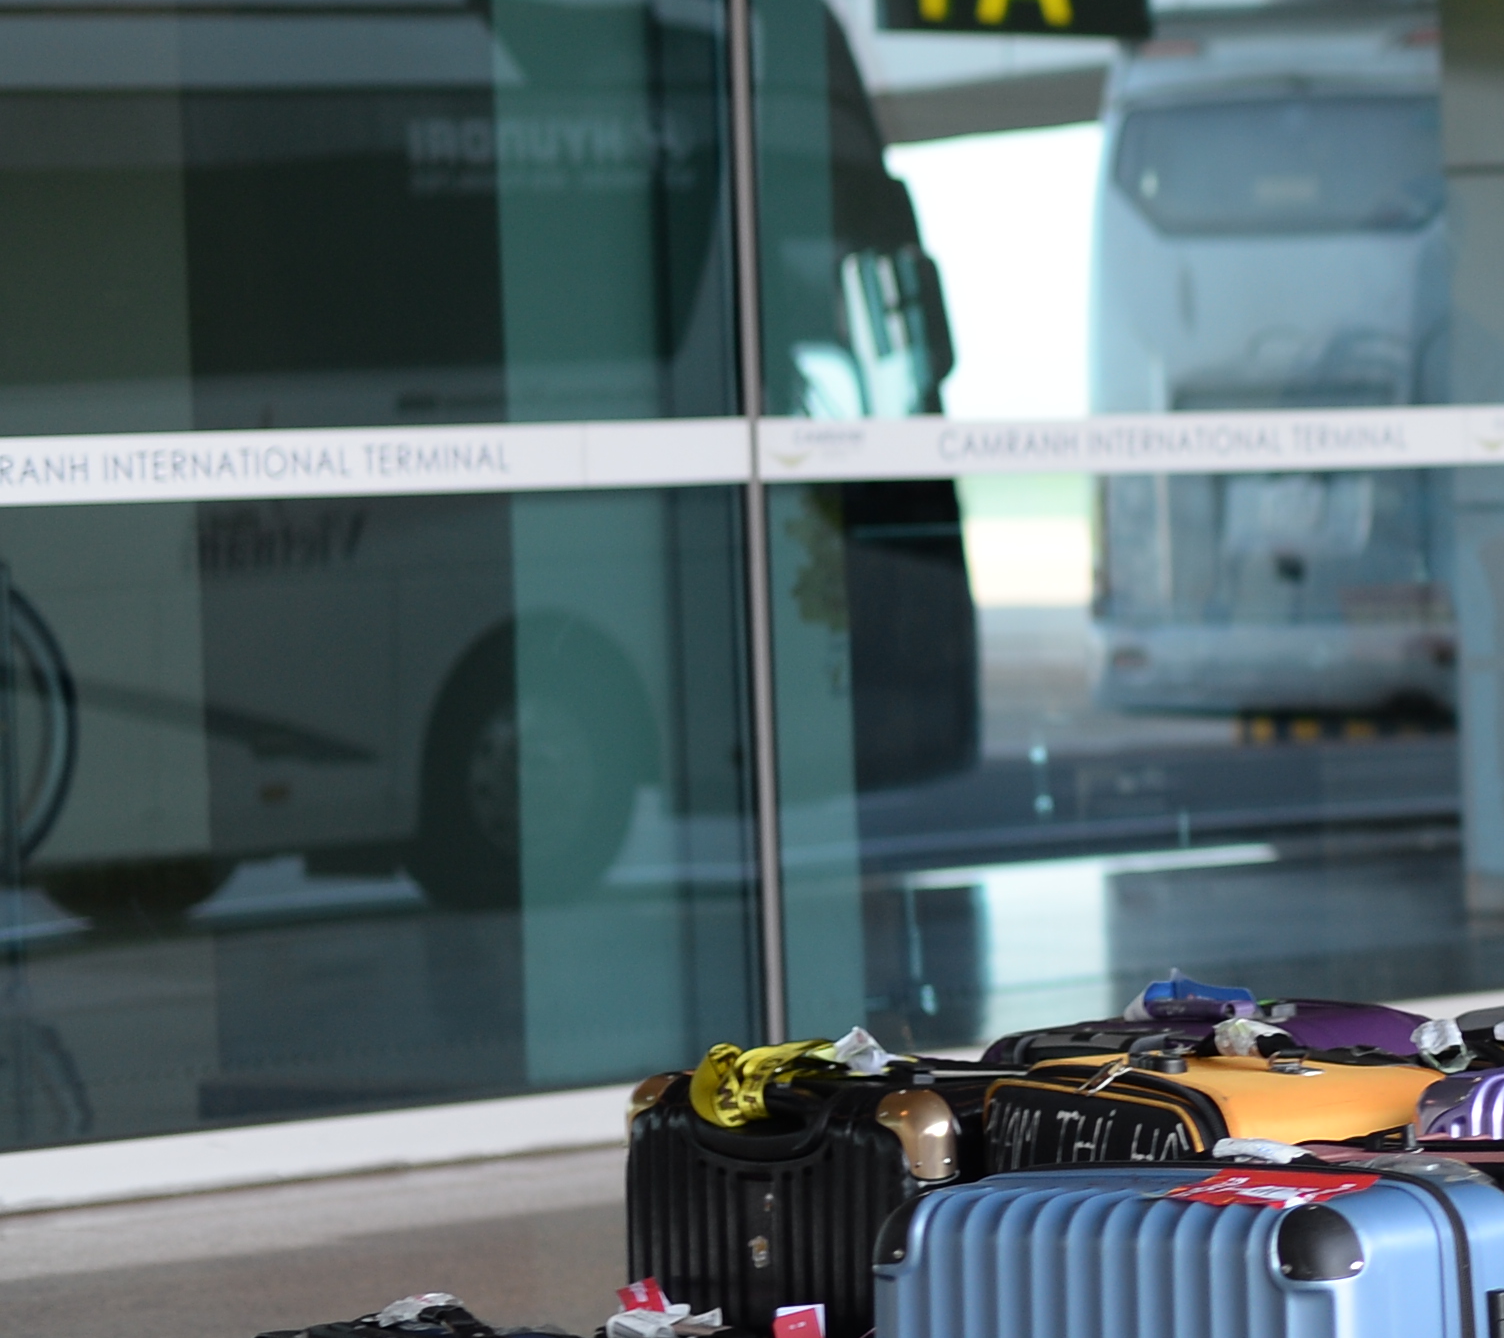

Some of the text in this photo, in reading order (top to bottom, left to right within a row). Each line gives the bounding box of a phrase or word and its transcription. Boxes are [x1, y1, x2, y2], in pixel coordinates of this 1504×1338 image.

[939, 419, 1408, 461] CAMRANH INTERNATIONAL TERMINAL
[102, 446, 352, 484] INTERNATIONAL
[363, 440, 511, 478] TERMINAL
